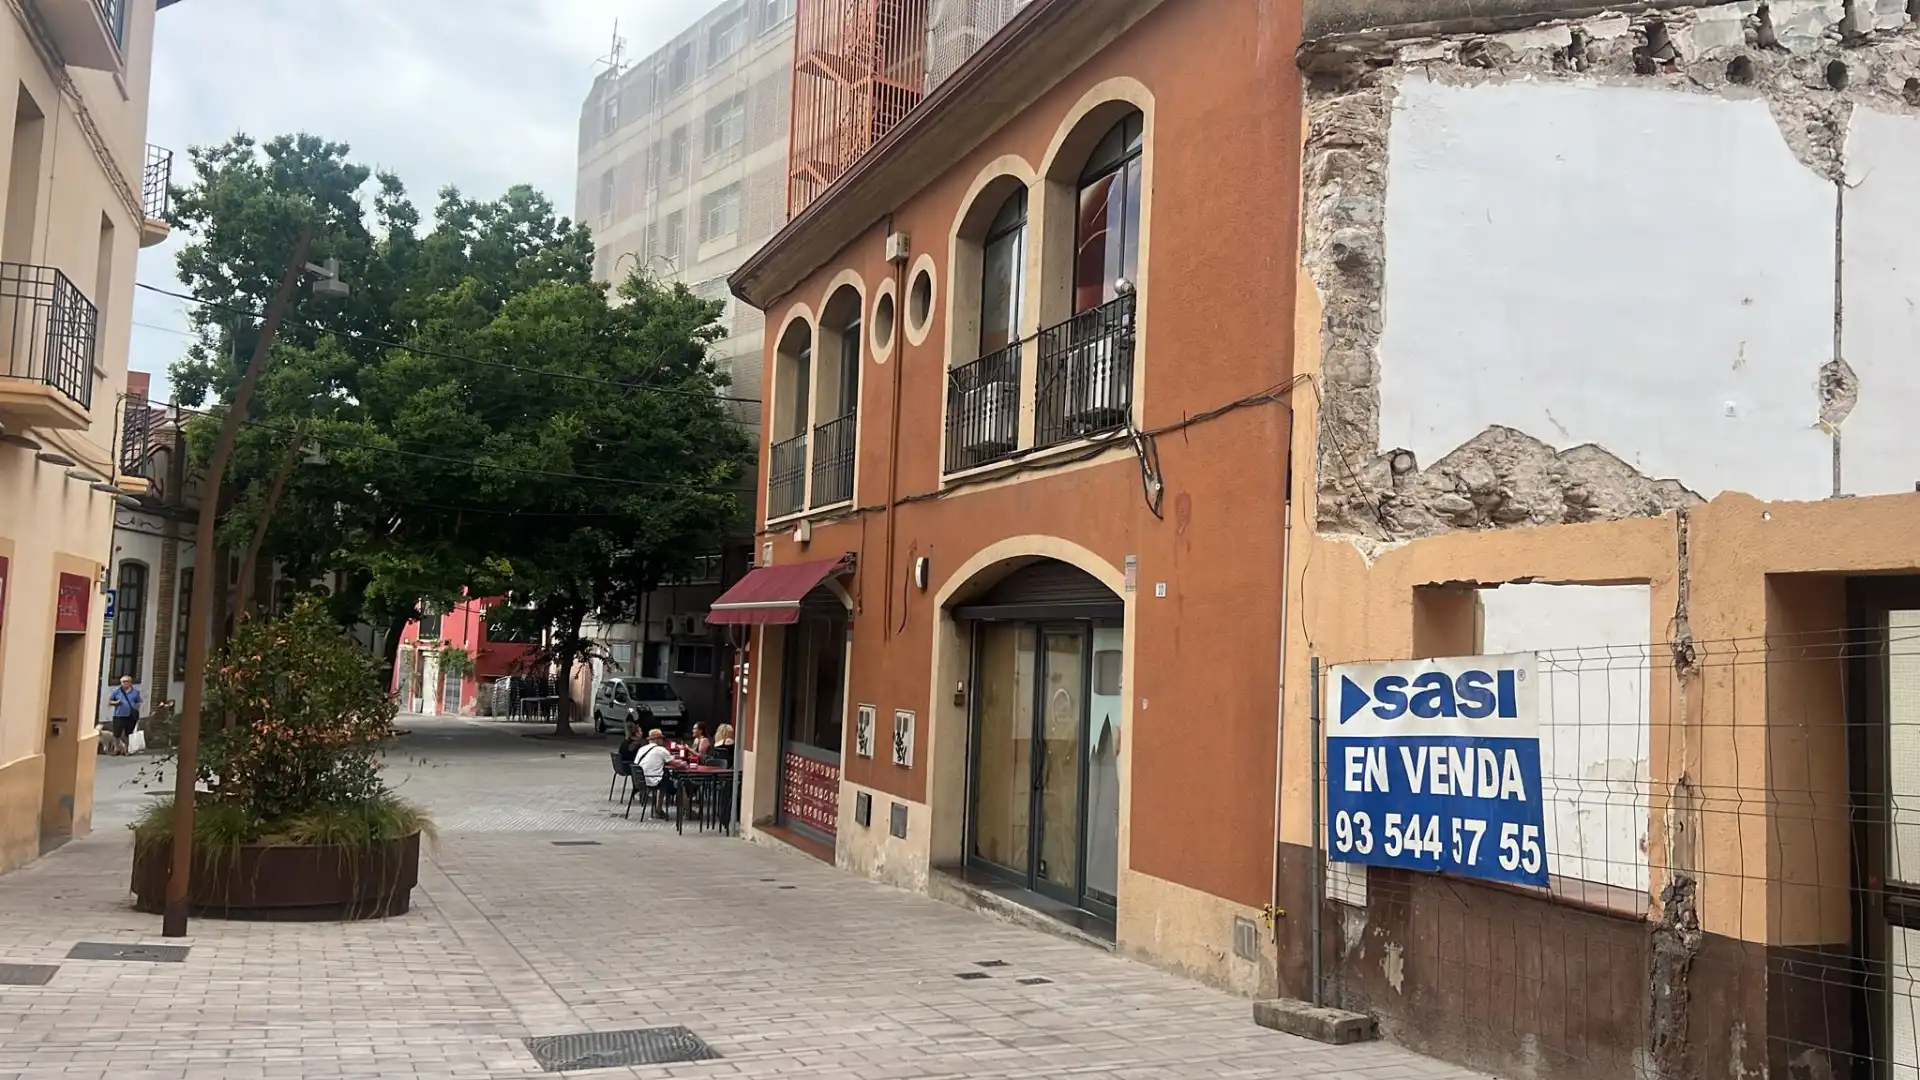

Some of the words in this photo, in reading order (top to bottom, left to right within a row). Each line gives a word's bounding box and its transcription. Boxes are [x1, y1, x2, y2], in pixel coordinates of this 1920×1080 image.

[1344, 746, 1389, 792] EN
[1399, 746, 1527, 801] VENDA
[1335, 810, 1374, 855] 93
[1384, 813, 1443, 861] 544
[1452, 817, 1488, 866] 57
[1498, 822, 1542, 874] 55
